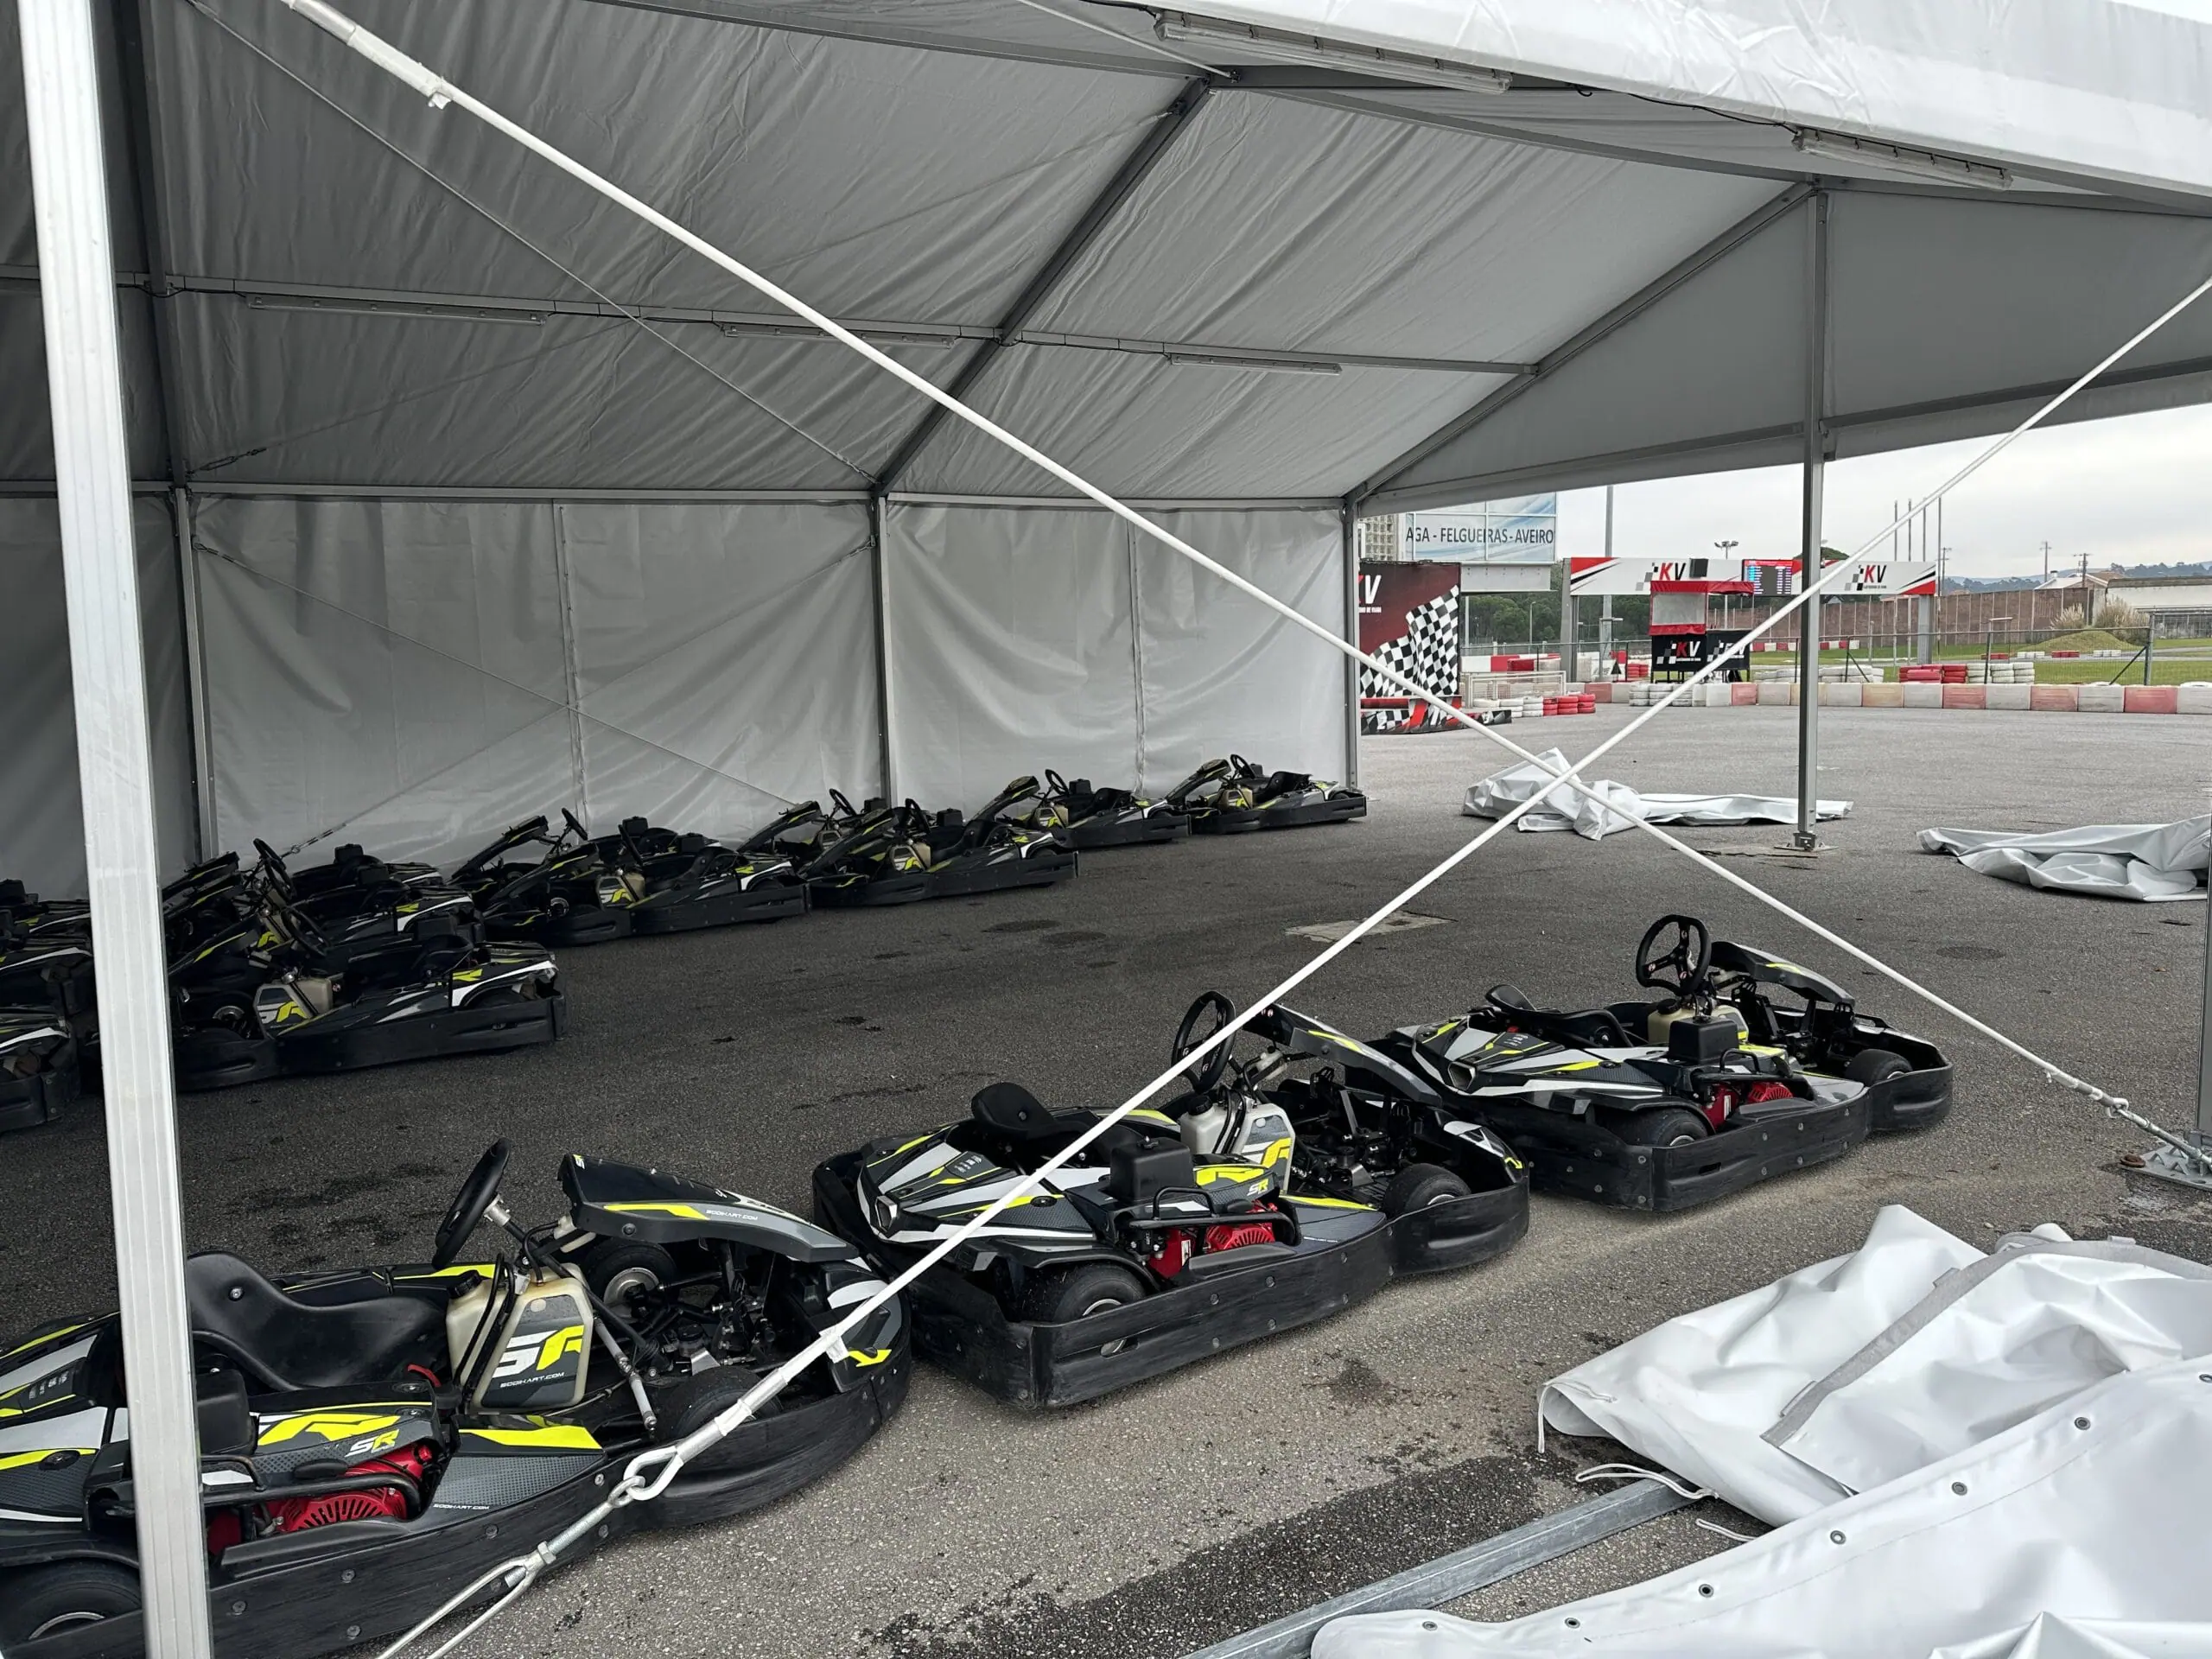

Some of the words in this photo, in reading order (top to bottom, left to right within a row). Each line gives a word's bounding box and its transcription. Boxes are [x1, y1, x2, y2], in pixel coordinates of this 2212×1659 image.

[1440, 527, 1508, 543] FELGUEIRAS
[1515, 529, 1554, 543] AVEIRO
[1659, 563, 1687, 581] KV
[1864, 564, 1887, 583] KV
[1358, 574, 1382, 604] V
[1676, 641, 1700, 658] KV
[1247, 1178, 1269, 1197] SR
[345, 1429, 400, 1459] SR
